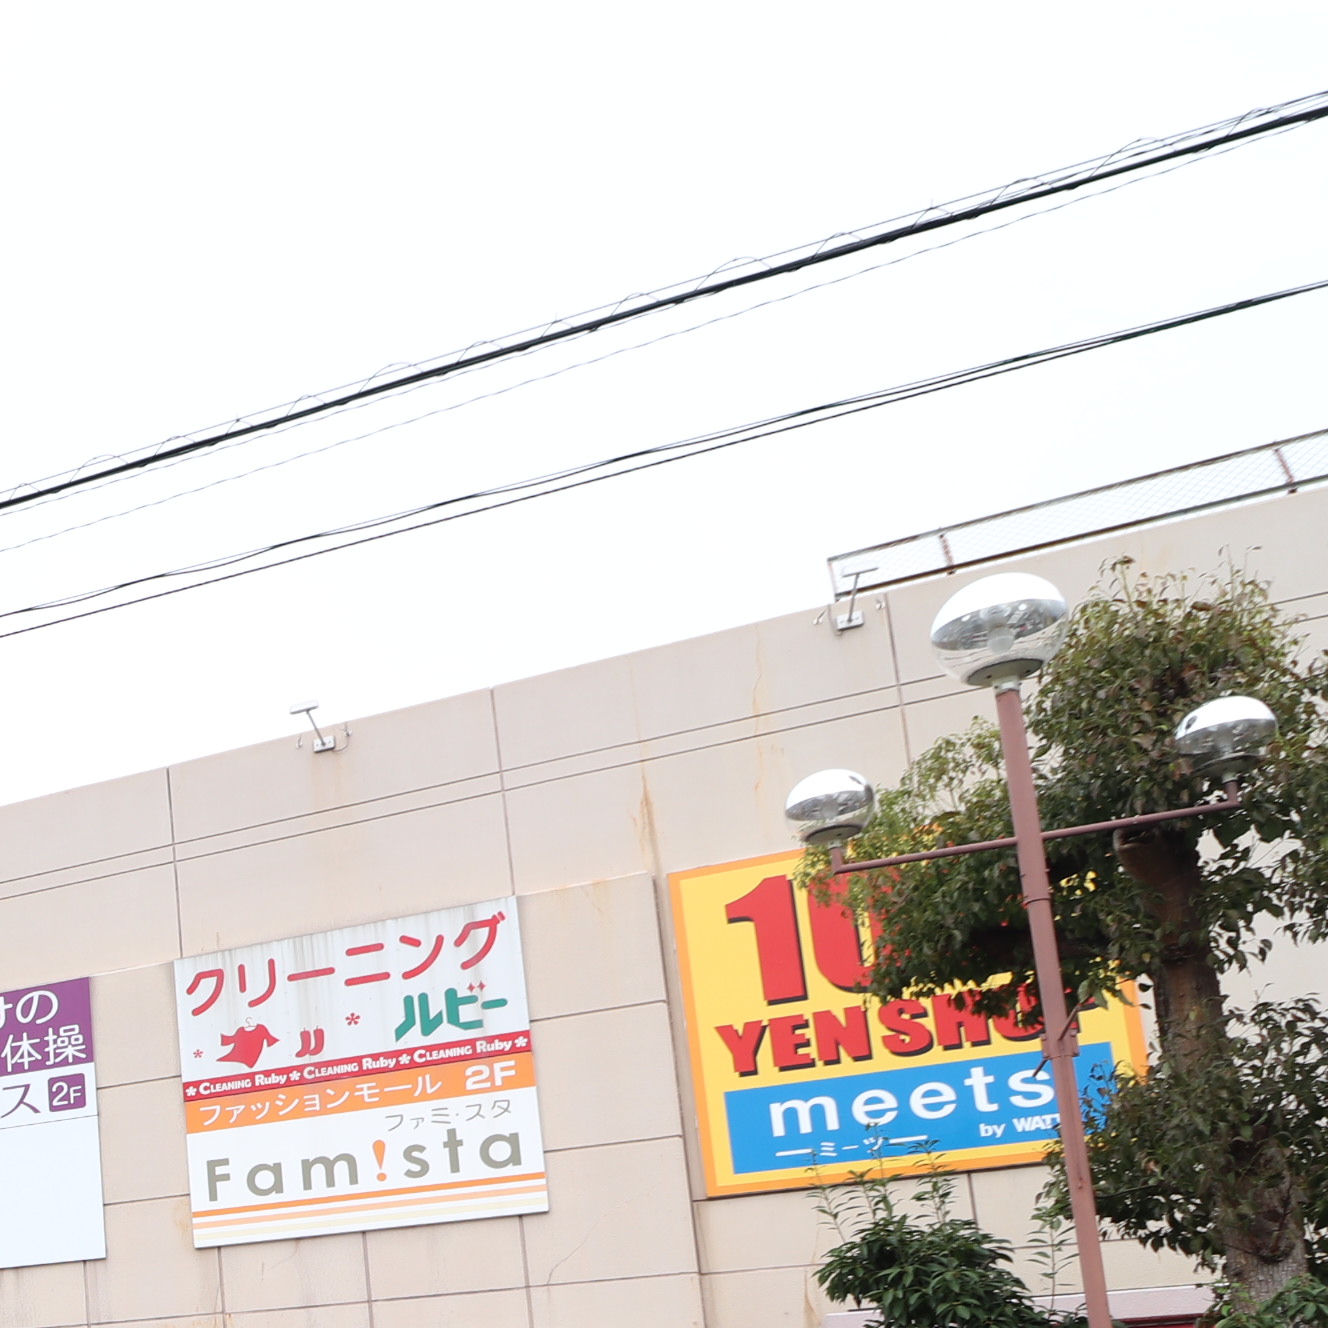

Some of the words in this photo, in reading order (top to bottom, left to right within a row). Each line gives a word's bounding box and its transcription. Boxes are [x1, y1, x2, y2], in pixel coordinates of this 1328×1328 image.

[186, 911, 506, 1016] クリーニング
[394, 980, 508, 1043] ルビー
[715, 1004, 873, 1078] YEN
[878, 990, 1100, 1058] SHO
[51, 1081, 82, 1107] 2F
[199, 1073, 442, 1127] ファッションモール
[464, 1060, 516, 1091] 2F
[254, 1070, 288, 1088] Ruby
[362, 1055, 397, 1073] Ruby
[476, 1037, 513, 1055] Ruby
[769, 1066, 1056, 1138] meets
[979, 1122, 1006, 1138] by
